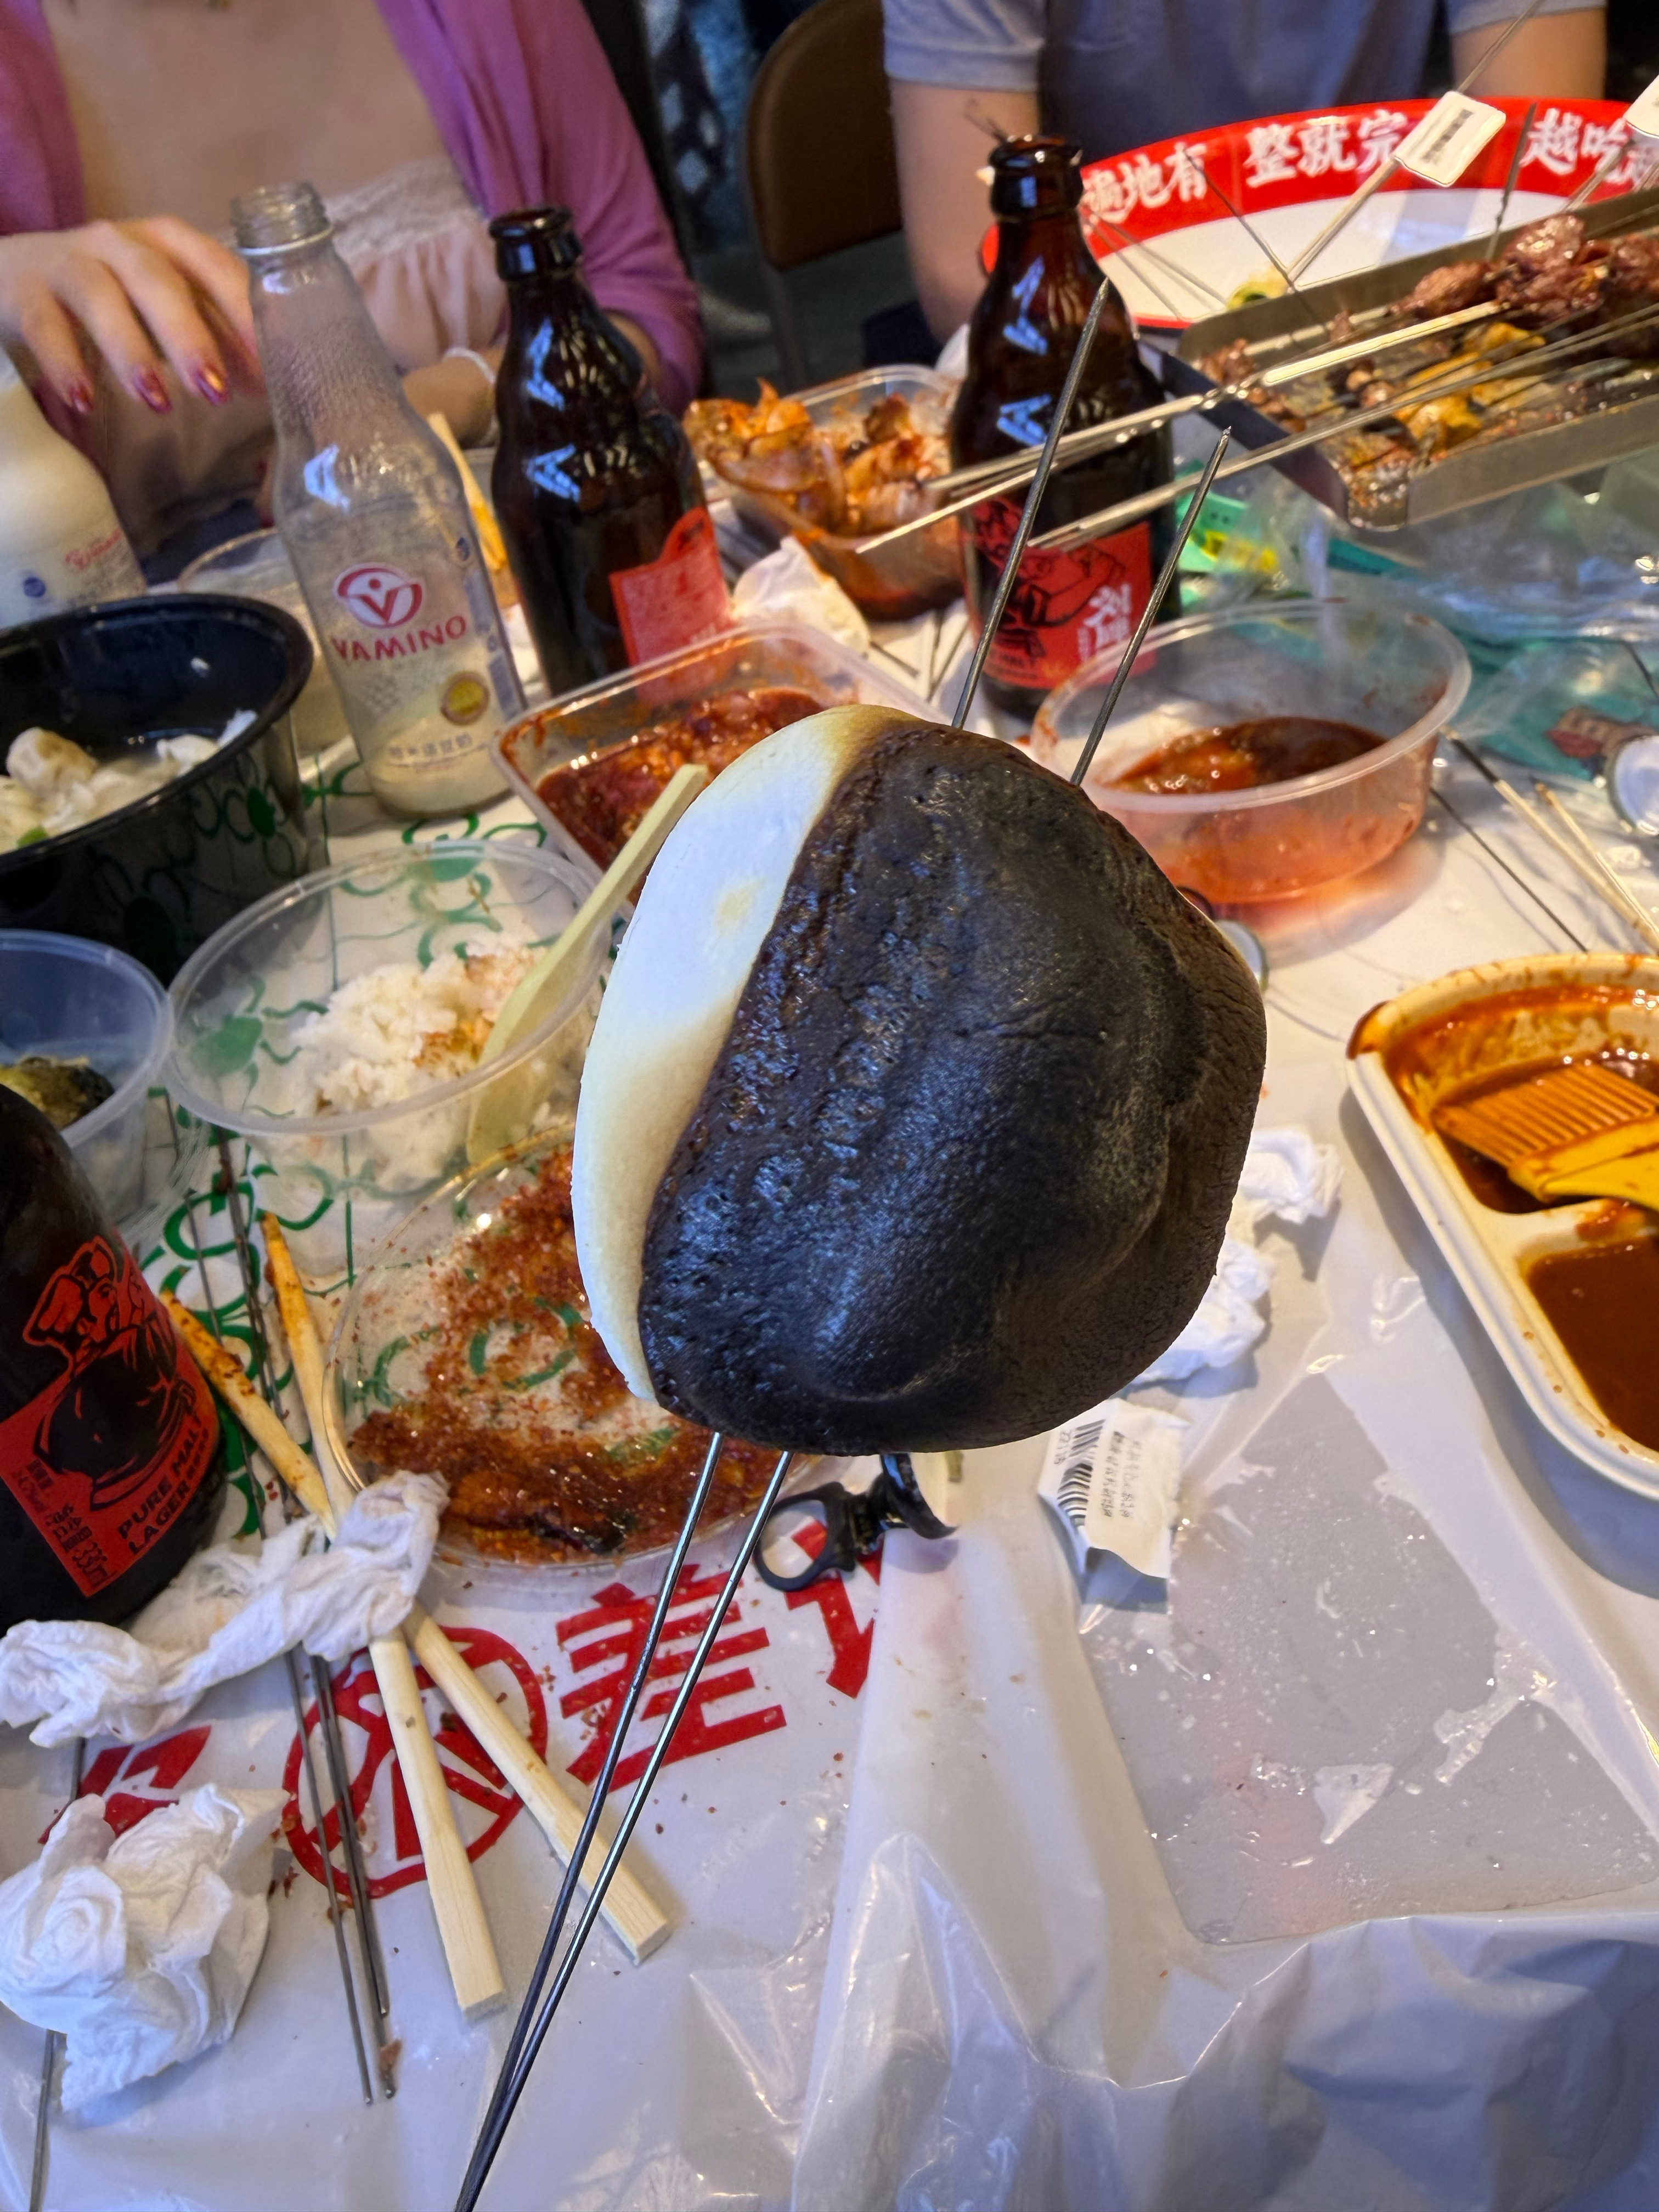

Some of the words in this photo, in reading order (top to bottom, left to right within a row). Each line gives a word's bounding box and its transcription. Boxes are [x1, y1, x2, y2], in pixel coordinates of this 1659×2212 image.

[332, 615, 466, 663] VAMINO
[117, 1476, 172, 1539] PURE
[128, 1480, 190, 1555] LAGER
